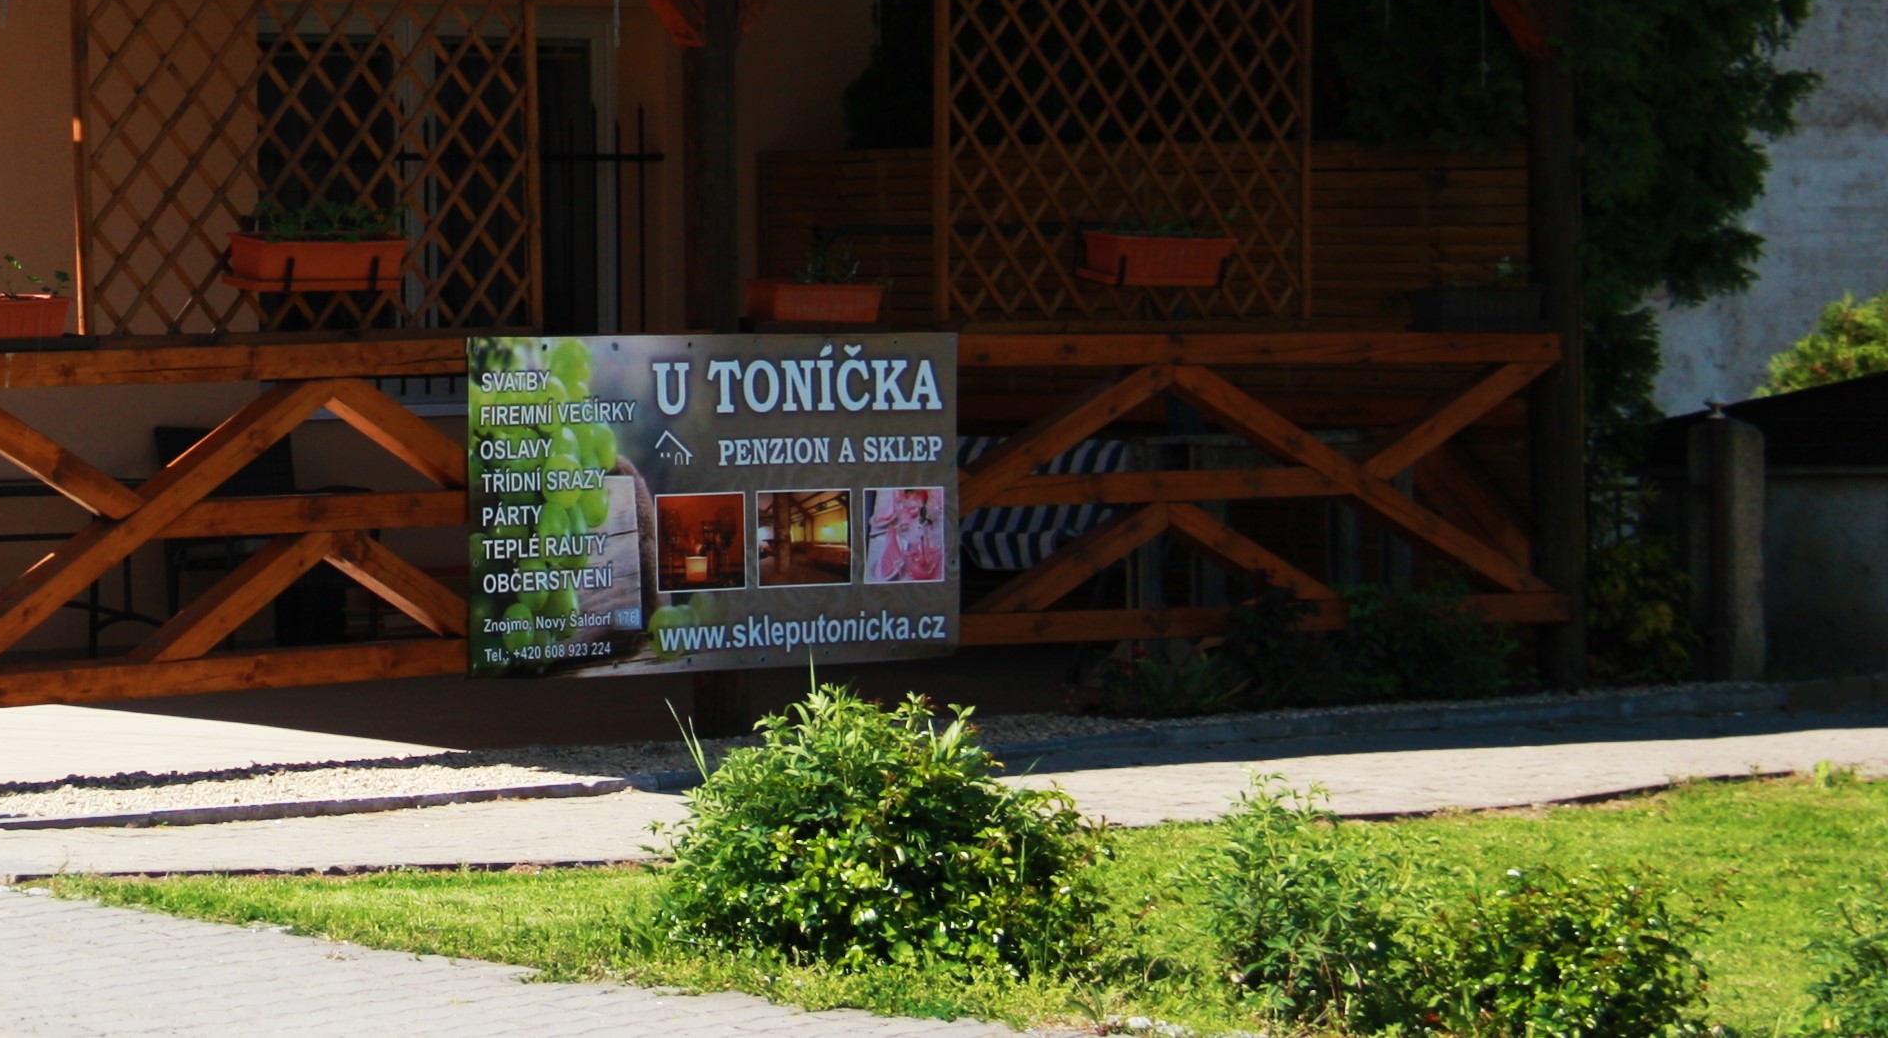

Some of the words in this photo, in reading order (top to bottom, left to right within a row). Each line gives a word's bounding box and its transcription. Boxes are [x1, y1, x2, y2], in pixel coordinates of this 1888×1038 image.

[480, 371, 551, 393] SVATBY
[651, 362, 690, 415] U
[706, 343, 943, 414] TONÍČKA
[479, 399, 553, 426] FIREMNÍ
[557, 398, 636, 424] VEČÍRKY
[479, 438, 553, 461] OSLAVY
[717, 437, 831, 467] PENZION
[838, 436, 856, 464] A
[862, 435, 943, 463] SKLEP
[481, 467, 541, 494] TŘÍDNÍ
[545, 469, 607, 491] SRAZY
[481, 502, 543, 527] PÁRTY
[481, 534, 540, 560] TEPLÉ
[544, 534, 608, 557] RAUTY
[482, 562, 613, 594] OBČERSTVENÍ
[483, 617, 532, 635] Znojmo,
[535, 614, 567, 632] Nový
[569, 610, 612, 628] Šaldorf
[658, 610, 946, 653] www.skleputonicka.cz
[512, 645, 542, 661] +420
[544, 644, 565, 659] 608
[568, 642, 588, 658] 923
[591, 641, 612, 656] 224
